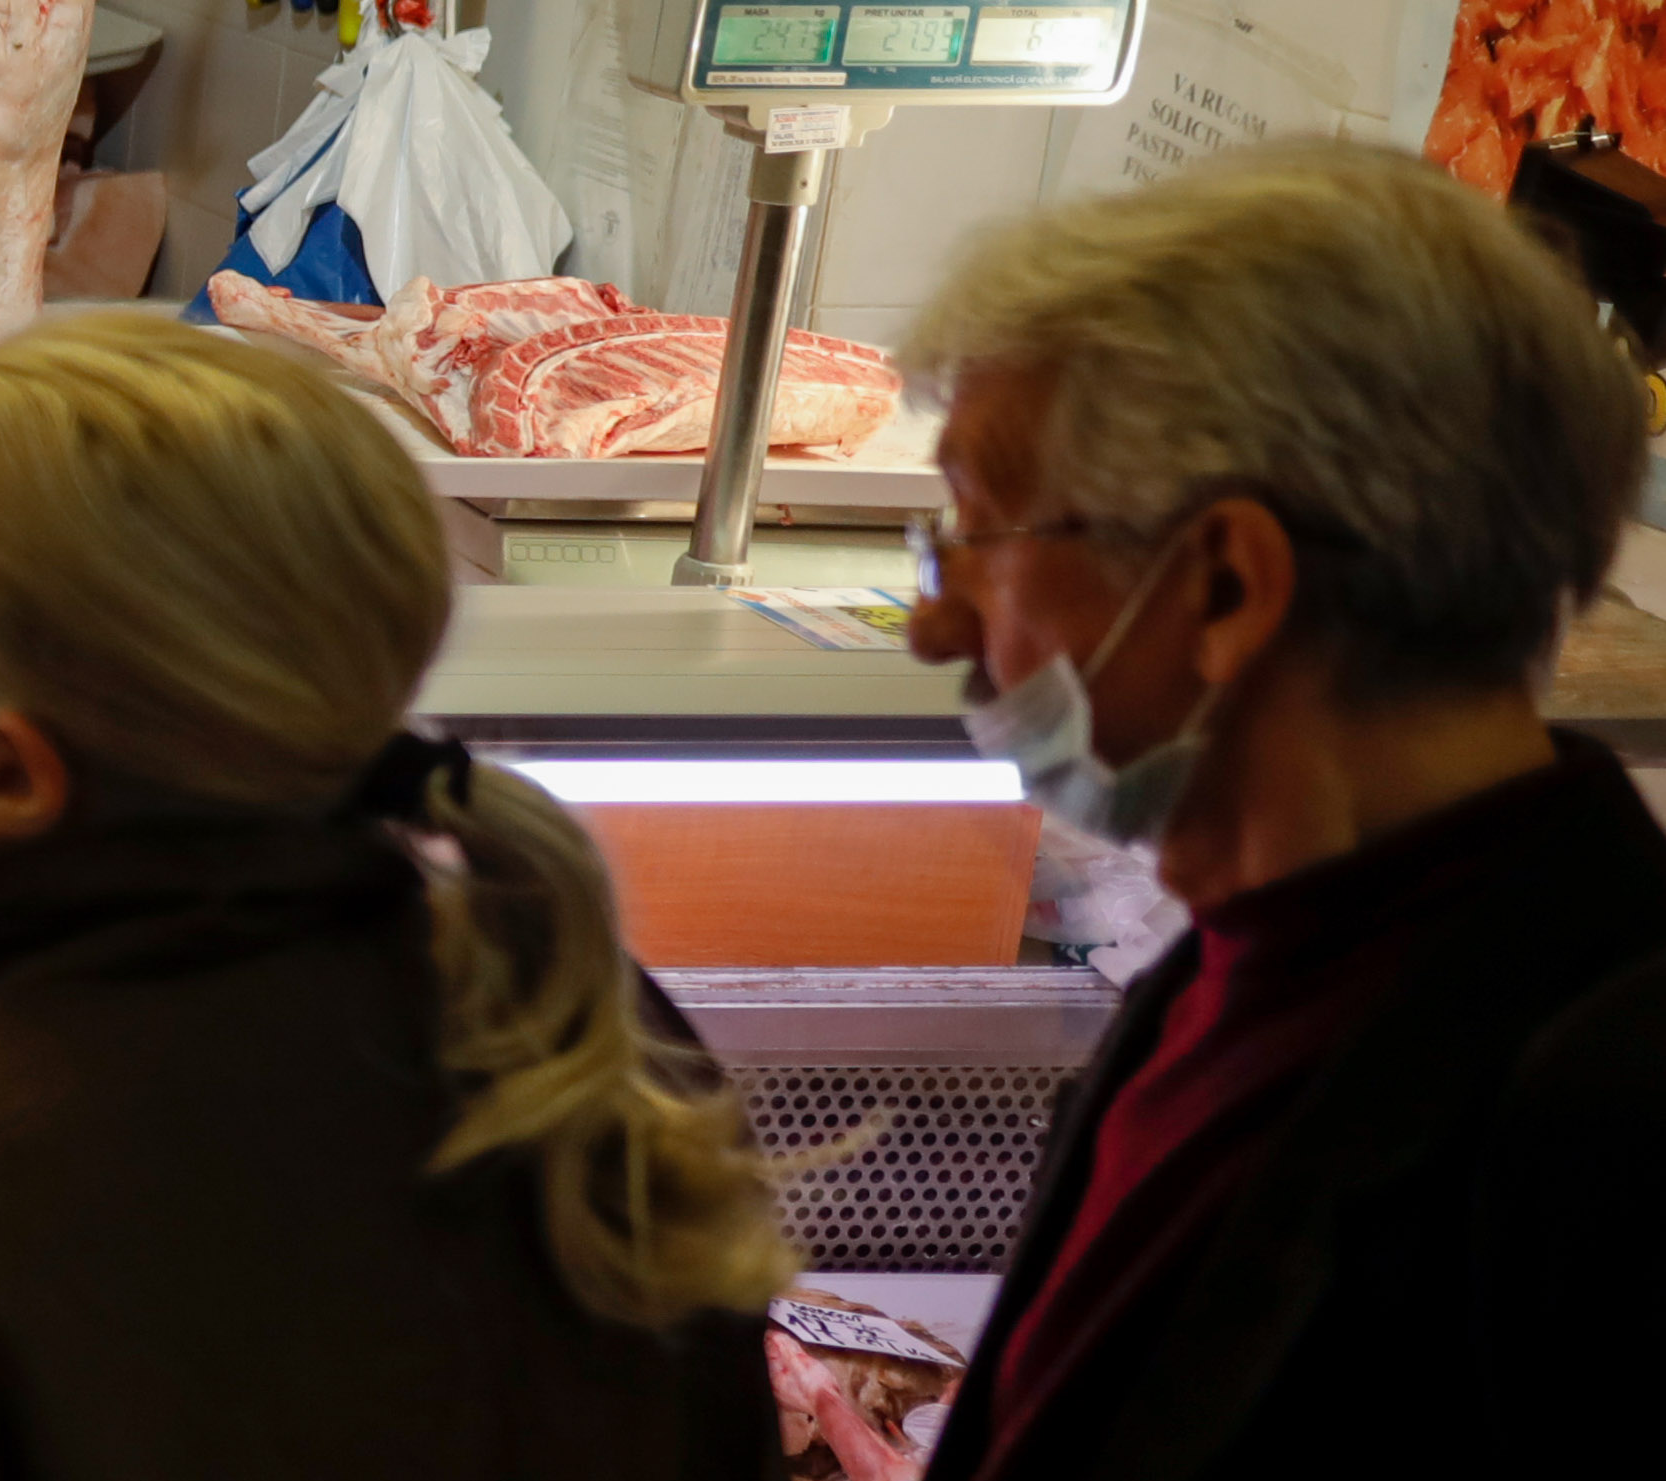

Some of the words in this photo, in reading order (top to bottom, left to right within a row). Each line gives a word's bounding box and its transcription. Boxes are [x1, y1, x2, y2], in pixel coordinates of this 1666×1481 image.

[745, 8, 771, 17] MASA
[891, 8, 925, 18] UNITAR
[1011, 8, 1039, 18] TOTAL
[1150, 98, 1228, 151] SOLICIT
[1126, 122, 1188, 166] PASTR
